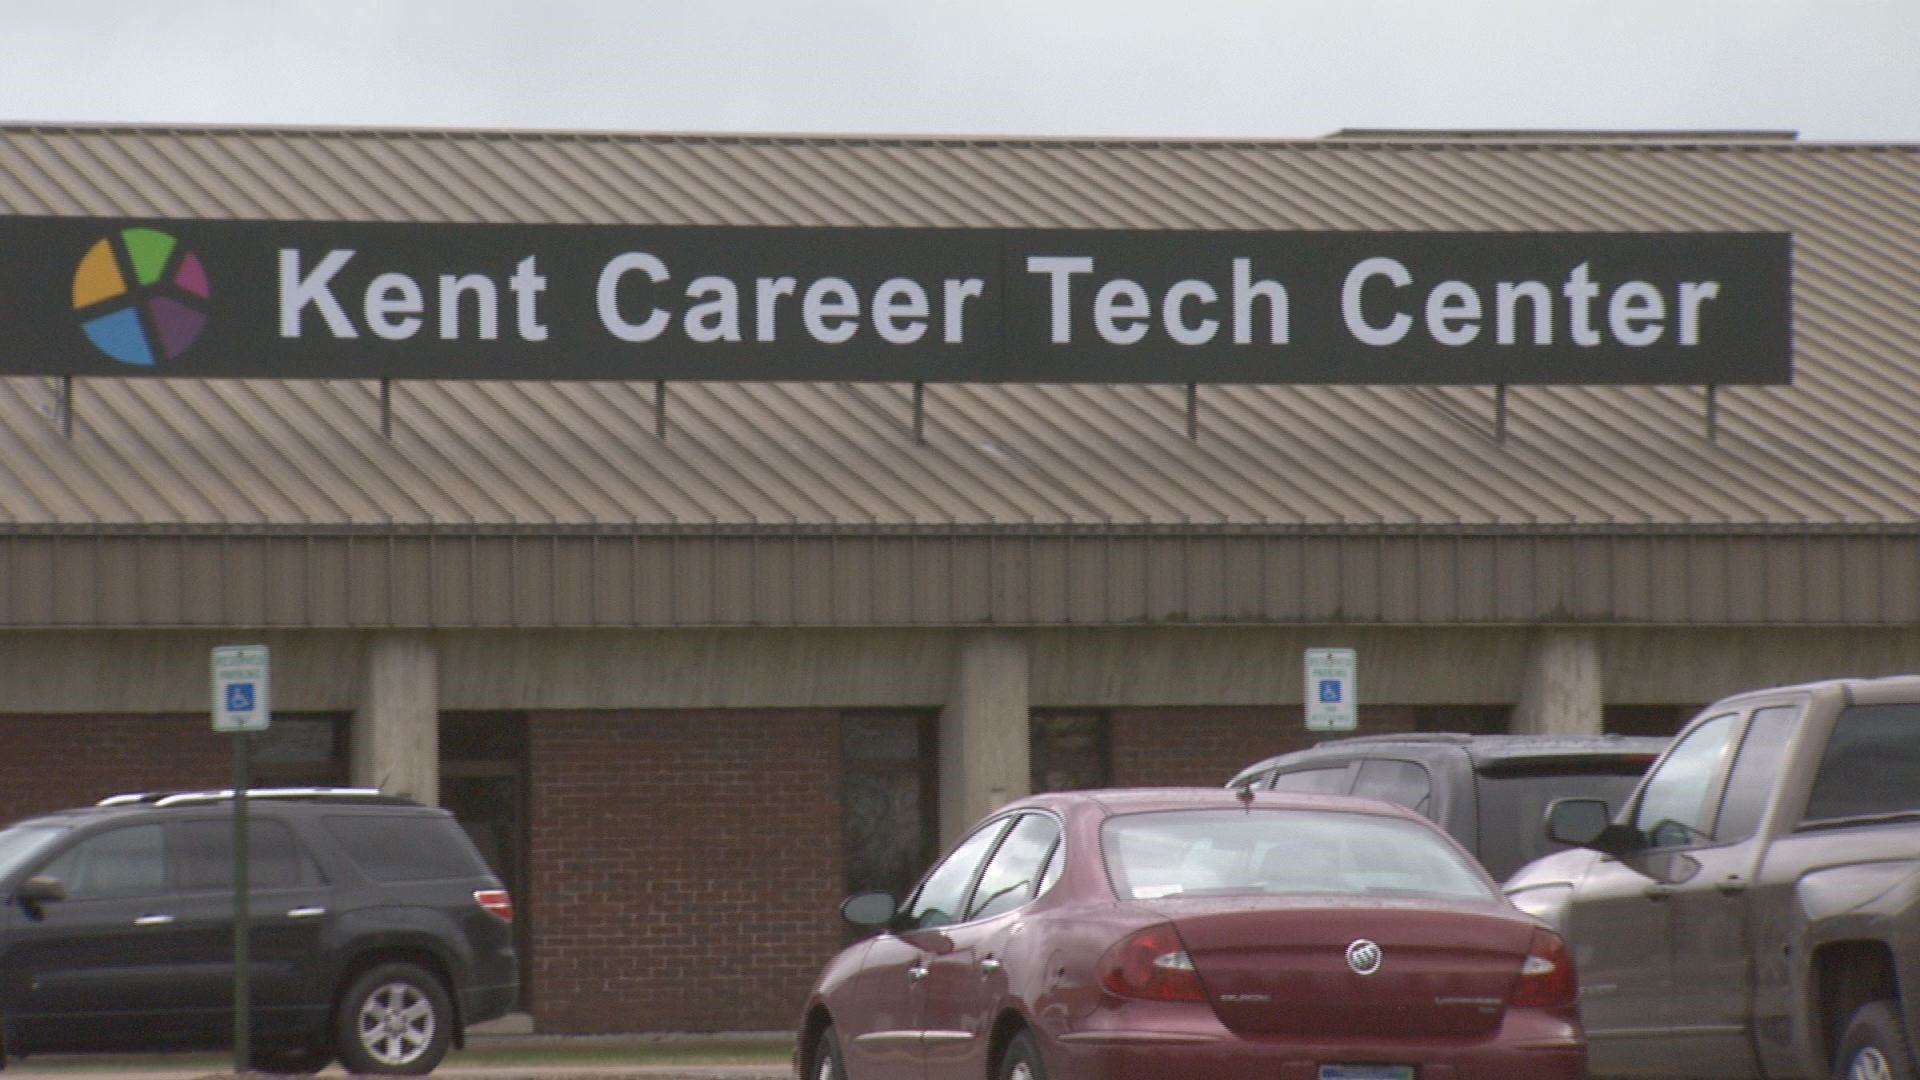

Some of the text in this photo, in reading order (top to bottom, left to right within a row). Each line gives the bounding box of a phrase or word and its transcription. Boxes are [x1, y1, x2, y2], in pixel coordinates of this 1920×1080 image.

[280, 249, 1719, 347] Kent Career Tech Center
